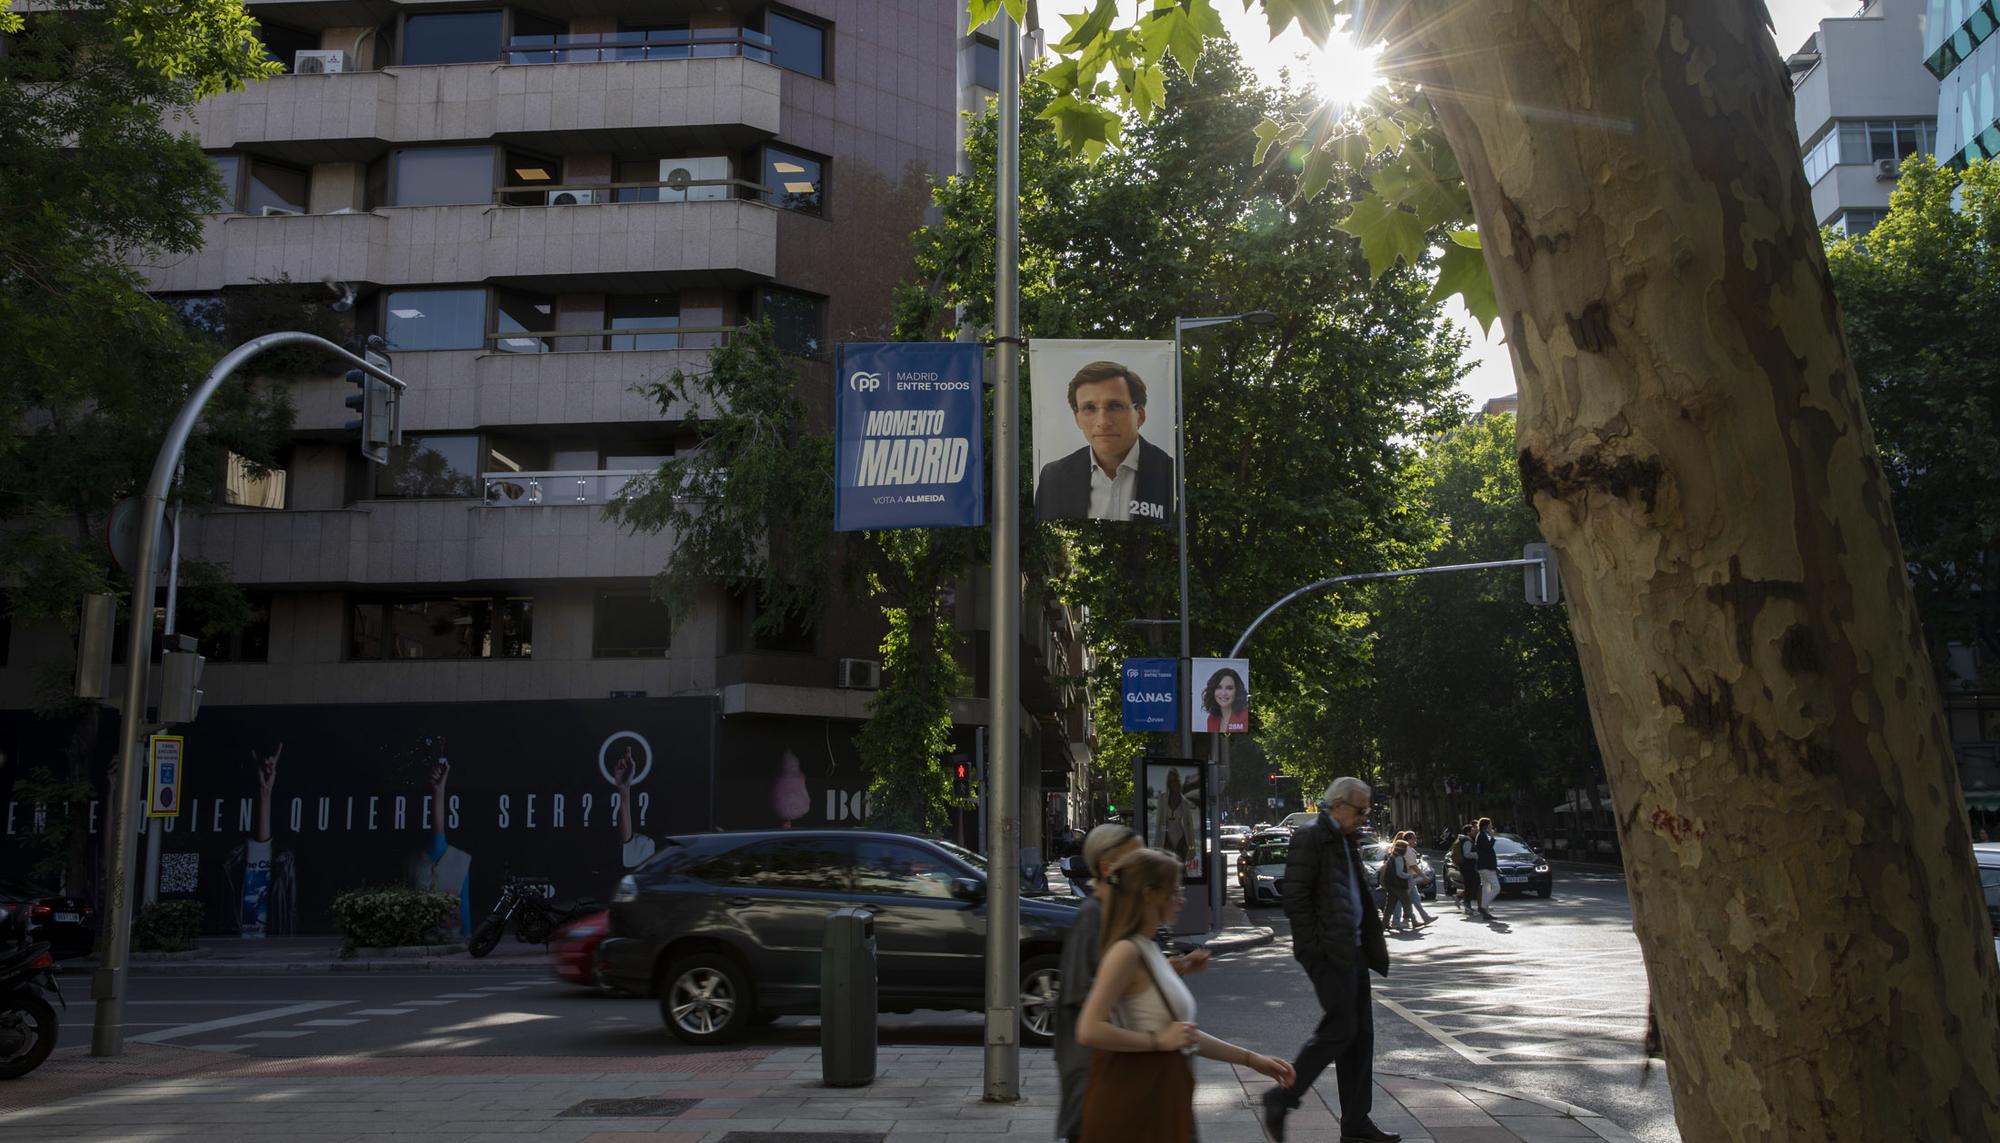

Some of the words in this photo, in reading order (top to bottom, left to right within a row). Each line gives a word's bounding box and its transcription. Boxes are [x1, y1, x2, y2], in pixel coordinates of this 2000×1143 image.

[896, 372, 938, 381] MADRID
[896, 382, 931, 391] ENTRE
[934, 381, 970, 391] TODOS
[866, 409, 945, 437] MOMENTO
[857, 437, 969, 487] MADRID
[873, 495, 896, 505] VOTA
[897, 495, 904, 503] A
[904, 494, 945, 503] ALMEIDA
[1129, 499, 1165, 520] 28M
[1126, 692, 1173, 703] GANAS
[289, 793, 461, 832] QUIERES
[498, 791, 650, 829] SER???
